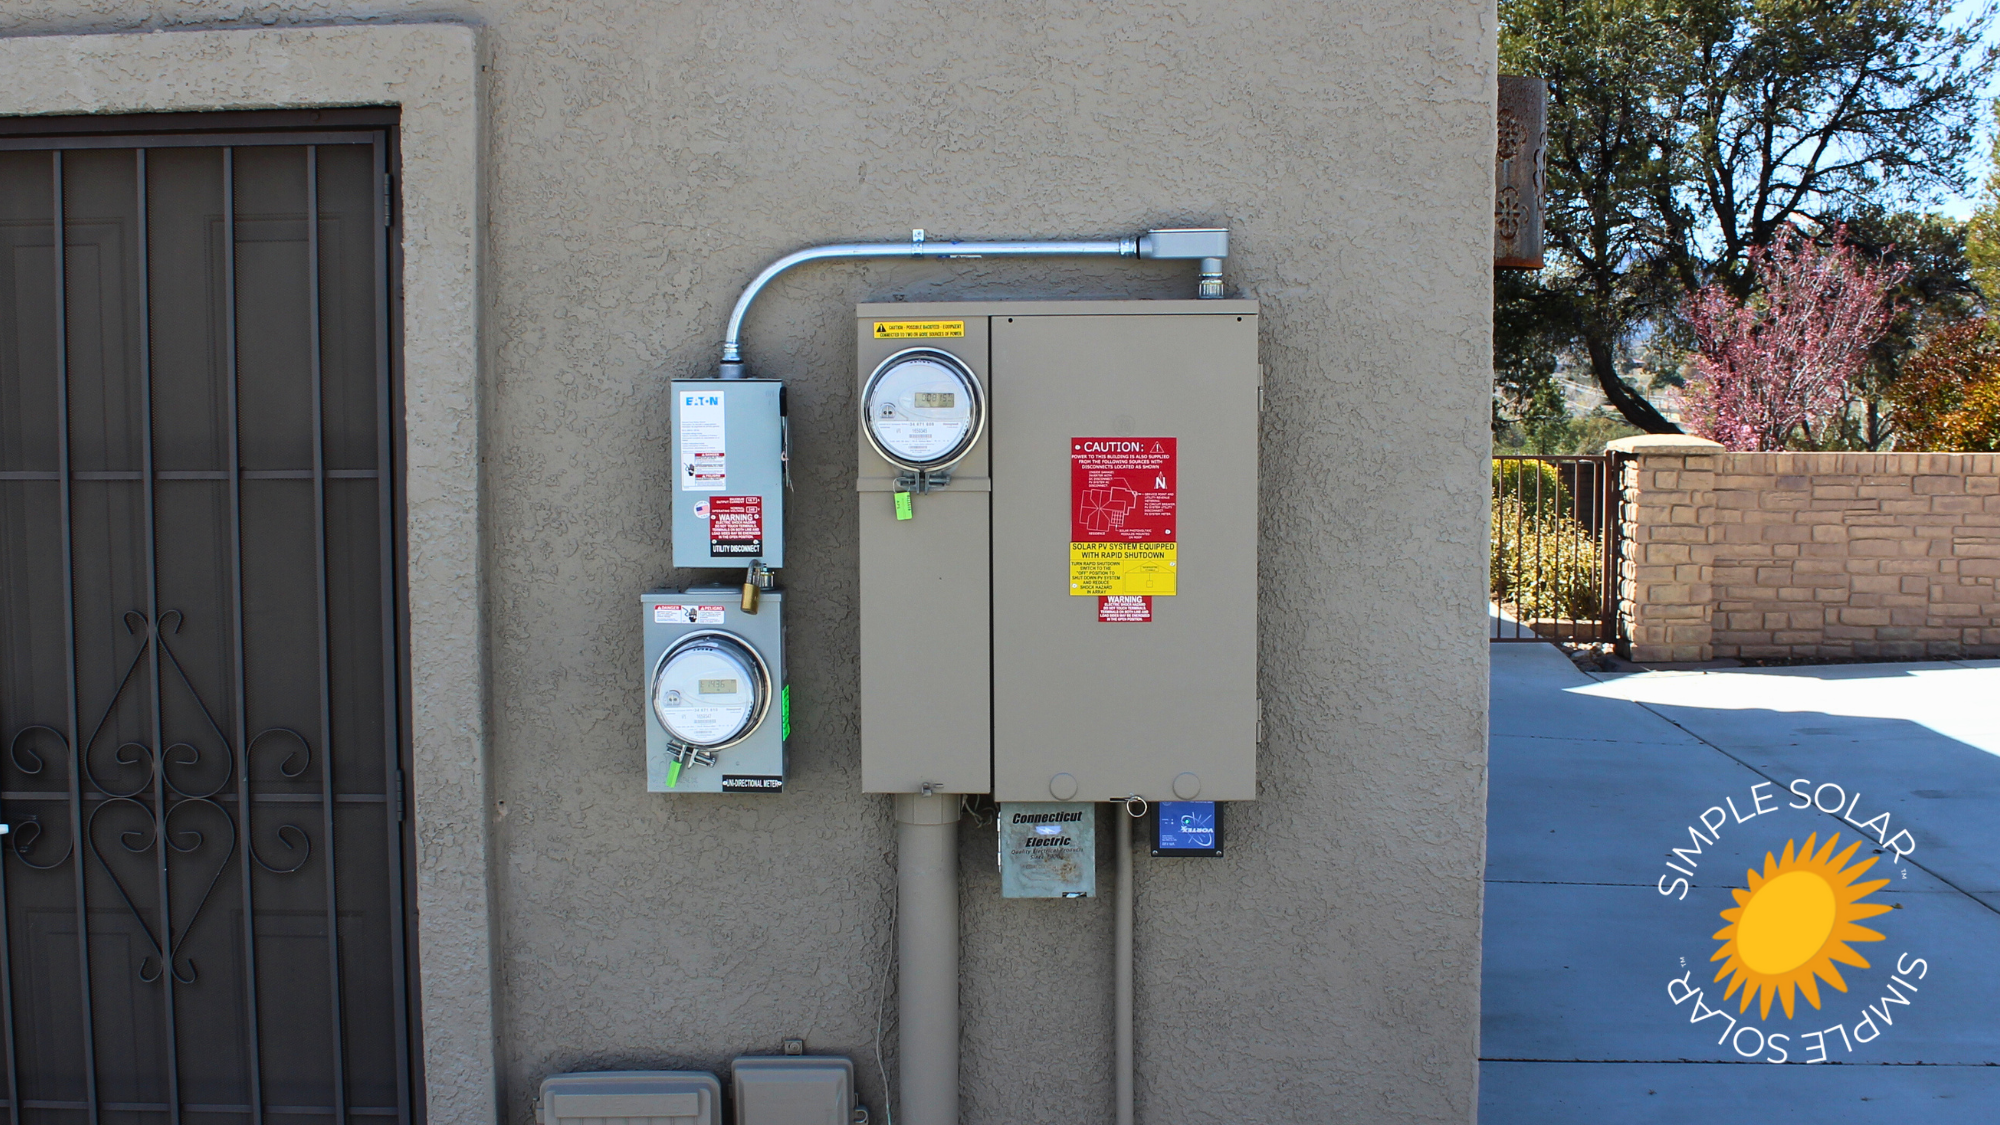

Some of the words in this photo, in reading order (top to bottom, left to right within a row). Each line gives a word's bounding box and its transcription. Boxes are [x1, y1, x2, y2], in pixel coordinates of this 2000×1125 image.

[1084, 442, 1144, 452] CAUTION:
[1155, 477, 1166, 489] N
[727, 779, 762, 787] UNI-DIRECTIONAL
[1012, 811, 1082, 824] Connecticut
[1025, 836, 1071, 847] Electric
